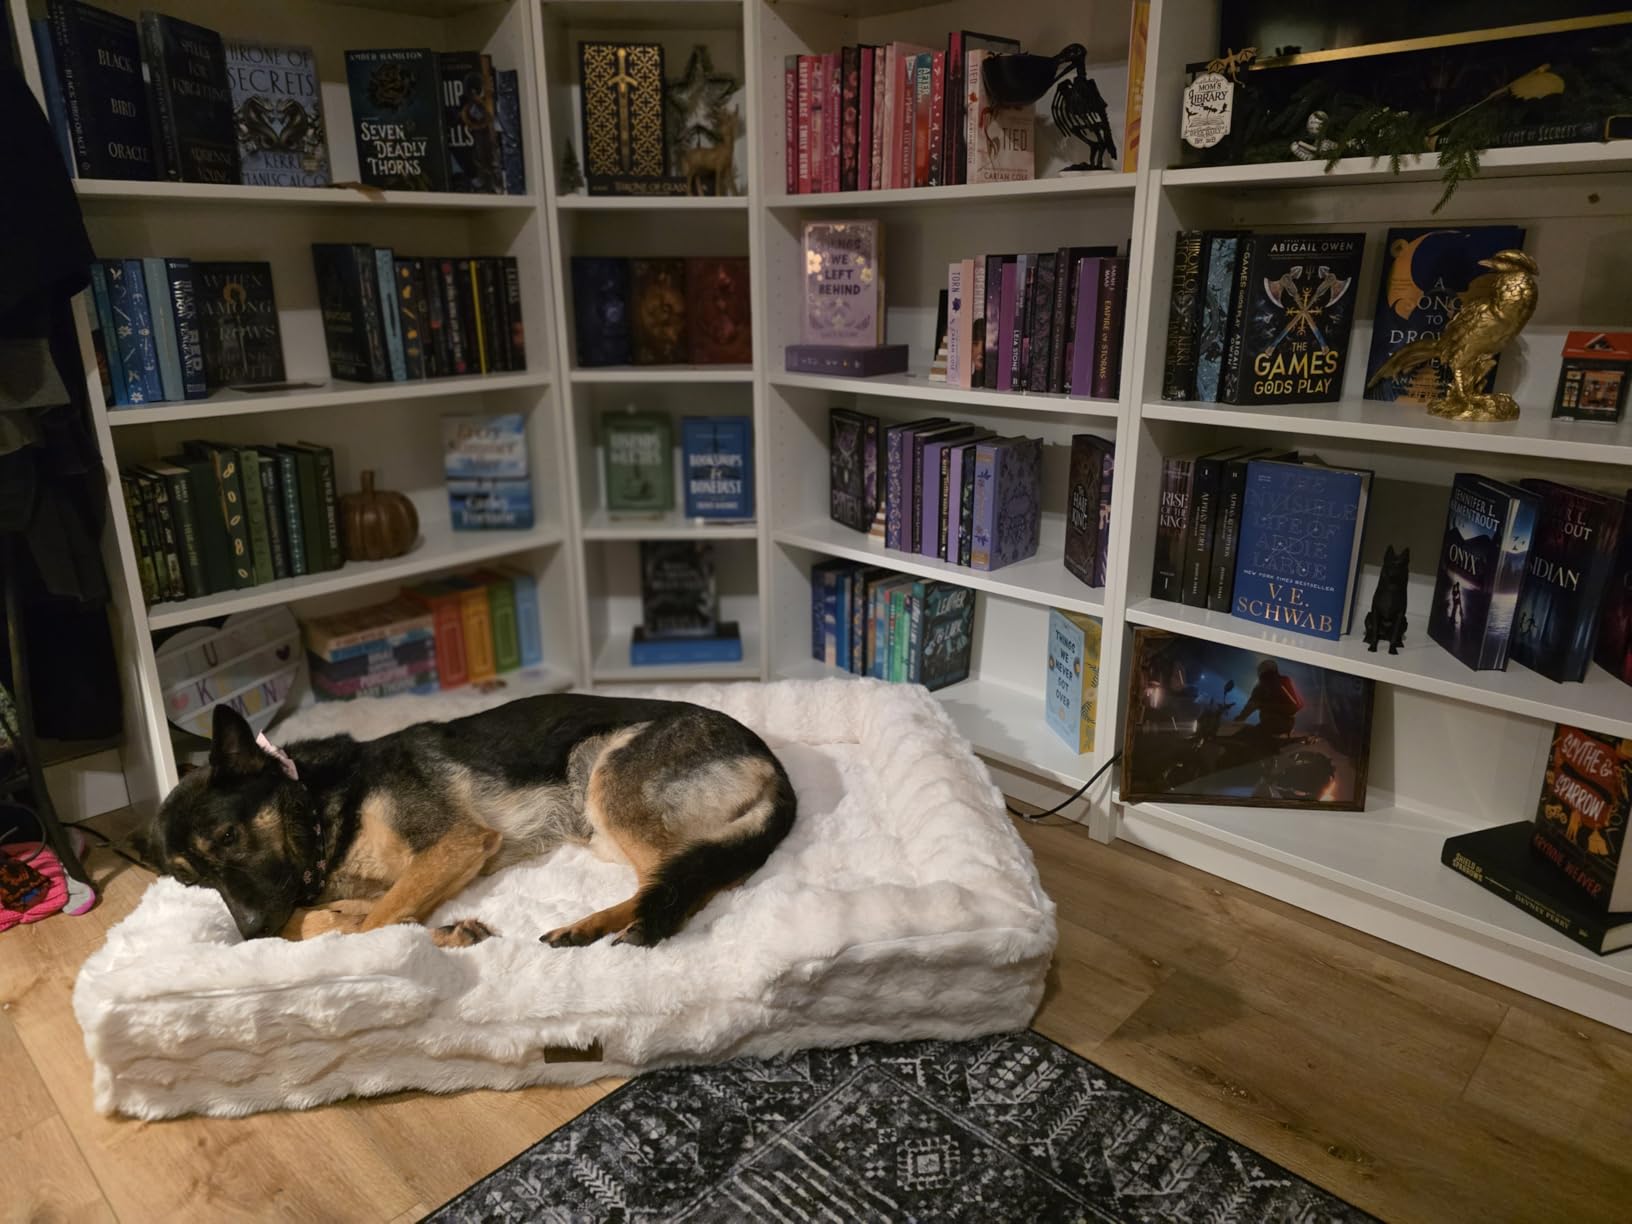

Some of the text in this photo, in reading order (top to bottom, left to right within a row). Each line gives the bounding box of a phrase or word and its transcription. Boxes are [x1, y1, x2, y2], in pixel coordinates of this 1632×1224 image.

[97, 49, 133, 73] BLACK
[287, 49, 313, 67] OF
[227, 67, 314, 97] SECRETS
[921, 67, 931, 95] AFTER
[969, 64, 978, 85] TIED
[799, 62, 808, 118] HAPPY PLACE
[1199, 82, 1222, 91] MOM'S
[111, 97, 137, 118] BIRD
[1188, 90, 1229, 107] LIBRARY
[361, 122, 405, 151] SEVEN
[1002, 127, 1029, 152] TIED
[373, 141, 428, 159] DEADLY
[367, 157, 422, 176] THORNS
[1270, 242, 1353, 253] ABIGAIL OWEN
[832, 254, 848, 265] WE
[1238, 251, 1249, 288] GAMES
[825, 269, 853, 281] LEFT
[951, 271, 961, 293] TORN
[1103, 269, 1111, 288] MAAS
[1434, 277, 1446, 289] A
[172, 279, 186, 318] WIDOW
[818, 283, 861, 296] BEHIND
[1417, 295, 1464, 311] ONG
[1102, 299, 1112, 332] EMPIRE
[1427, 314, 1444, 326] TO
[1231, 334, 1242, 370] ABIGAIL
[1291, 341, 1309, 352] THE
[1012, 347, 1020, 372] STONE
[1099, 344, 1109, 379] STORMS
[1254, 350, 1339, 380] GAMES
[1254, 377, 1331, 395] GODS PLAY
[1162, 491, 1189, 508] RISE
[1489, 503, 1498, 518] L.
[1160, 514, 1188, 530] KING
[1450, 544, 1477, 577] ONYX
[1243, 569, 1257, 577] NEW
[1259, 572, 1274, 580] YORK
[1294, 580, 1335, 593] BESTSELLER
[1270, 582, 1310, 608] V. E.
[1237, 597, 1333, 633] SCHWAB
[1055, 629, 1077, 654] THINGS
[1060, 647, 1070, 664] WE
[1055, 659, 1073, 682] NEVER
[1058, 677, 1070, 692] GOT
[1055, 688, 1071, 709] OVER
[1560, 733, 1604, 774] SCYTHE
[1554, 772, 1606, 822] SPARROW
